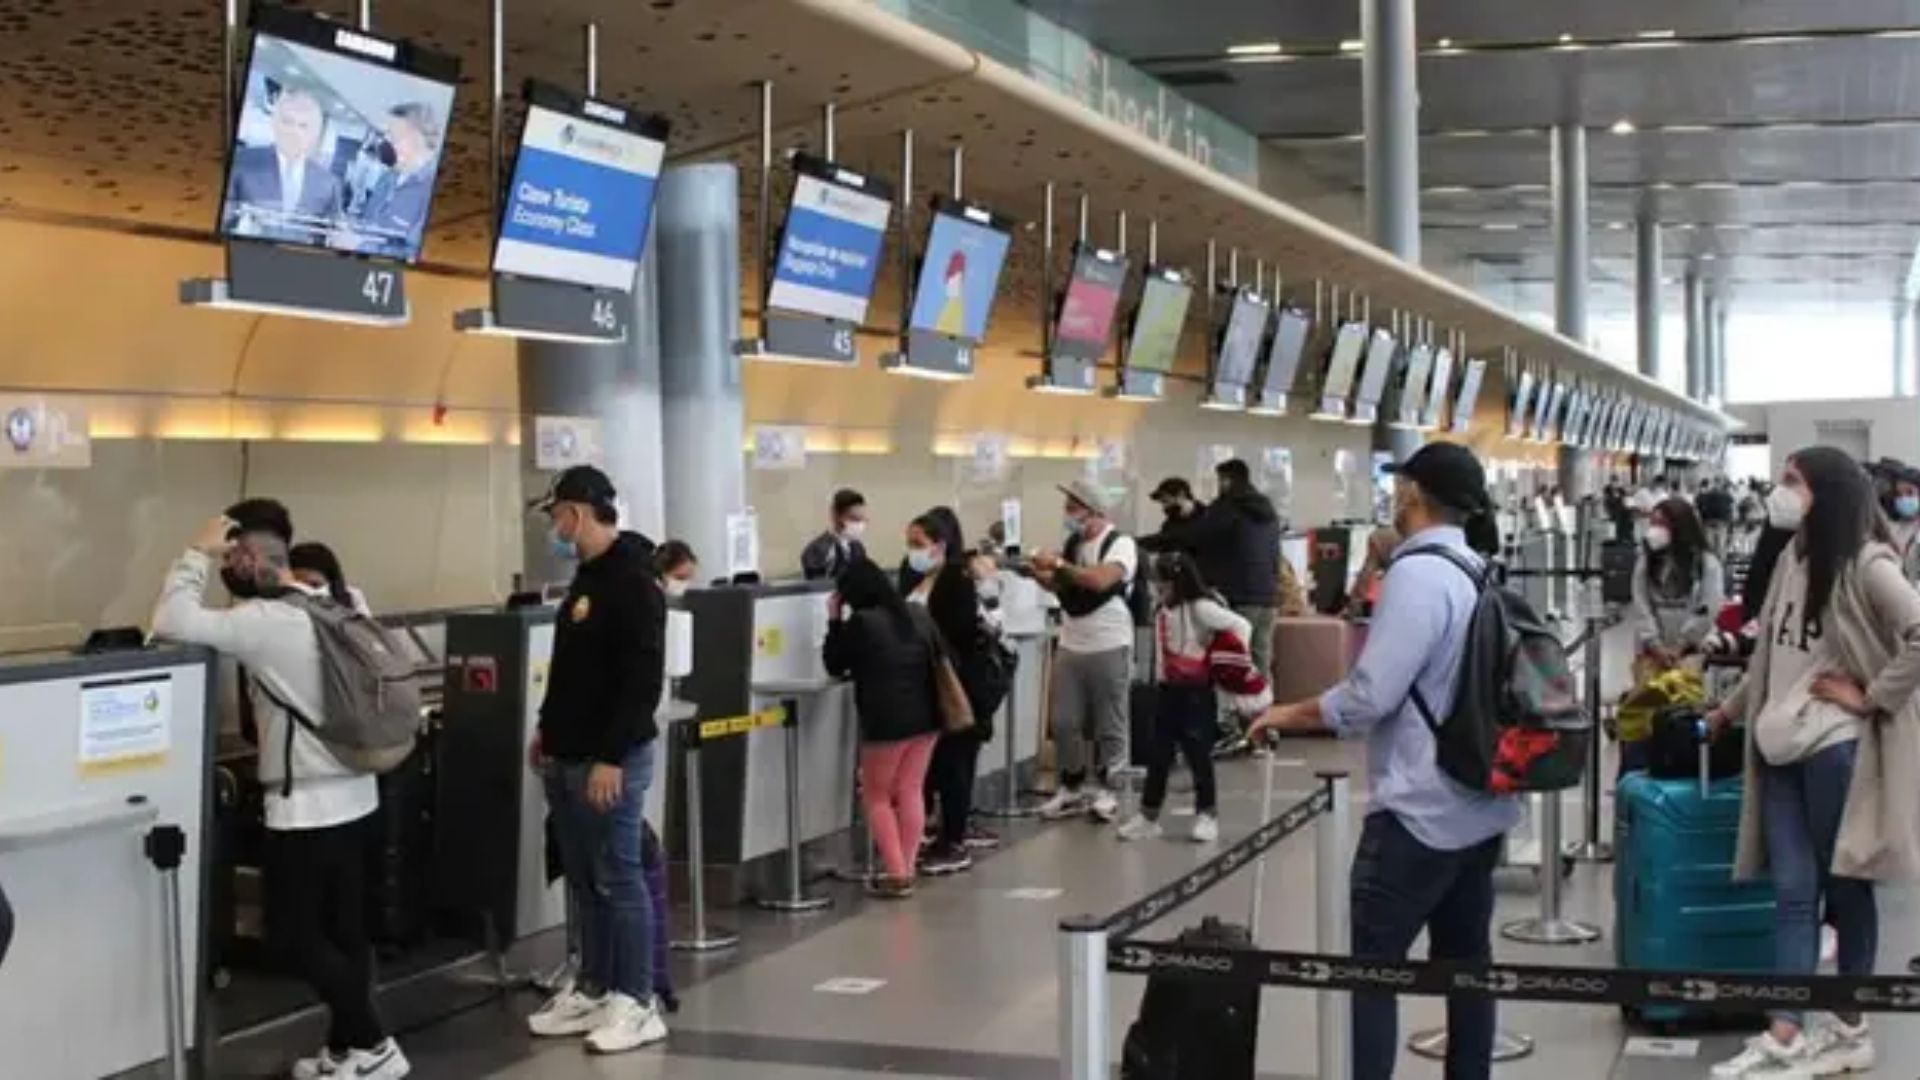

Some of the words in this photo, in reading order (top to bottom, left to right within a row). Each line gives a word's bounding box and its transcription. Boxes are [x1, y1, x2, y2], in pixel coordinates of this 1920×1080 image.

[1185, 100, 1208, 165] in
[362, 270, 394, 306] 47
[591, 299, 617, 330] 46
[834, 328, 852, 355] 45
